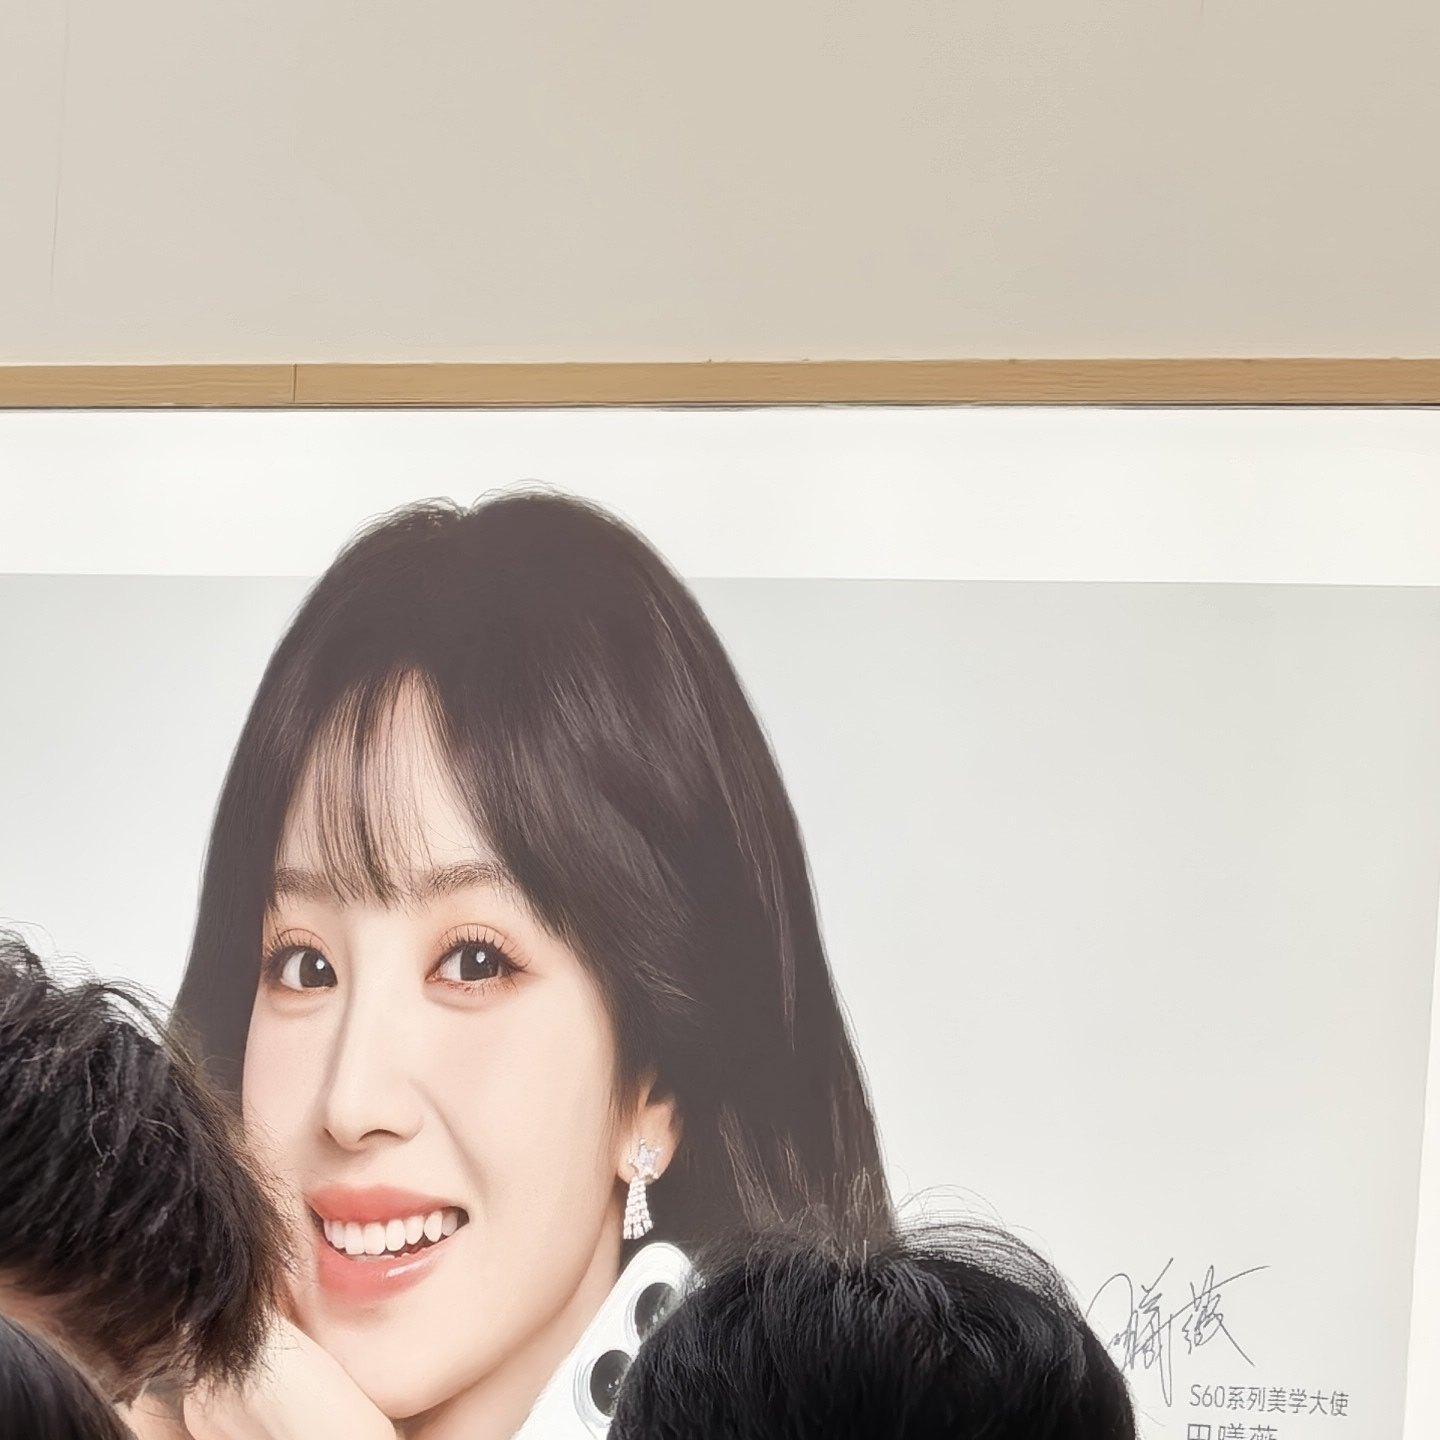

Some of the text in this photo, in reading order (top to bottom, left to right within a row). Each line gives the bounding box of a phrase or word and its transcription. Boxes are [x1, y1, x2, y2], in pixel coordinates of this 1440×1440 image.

[1189, 1384, 1350, 1417] S60系列美学大使
